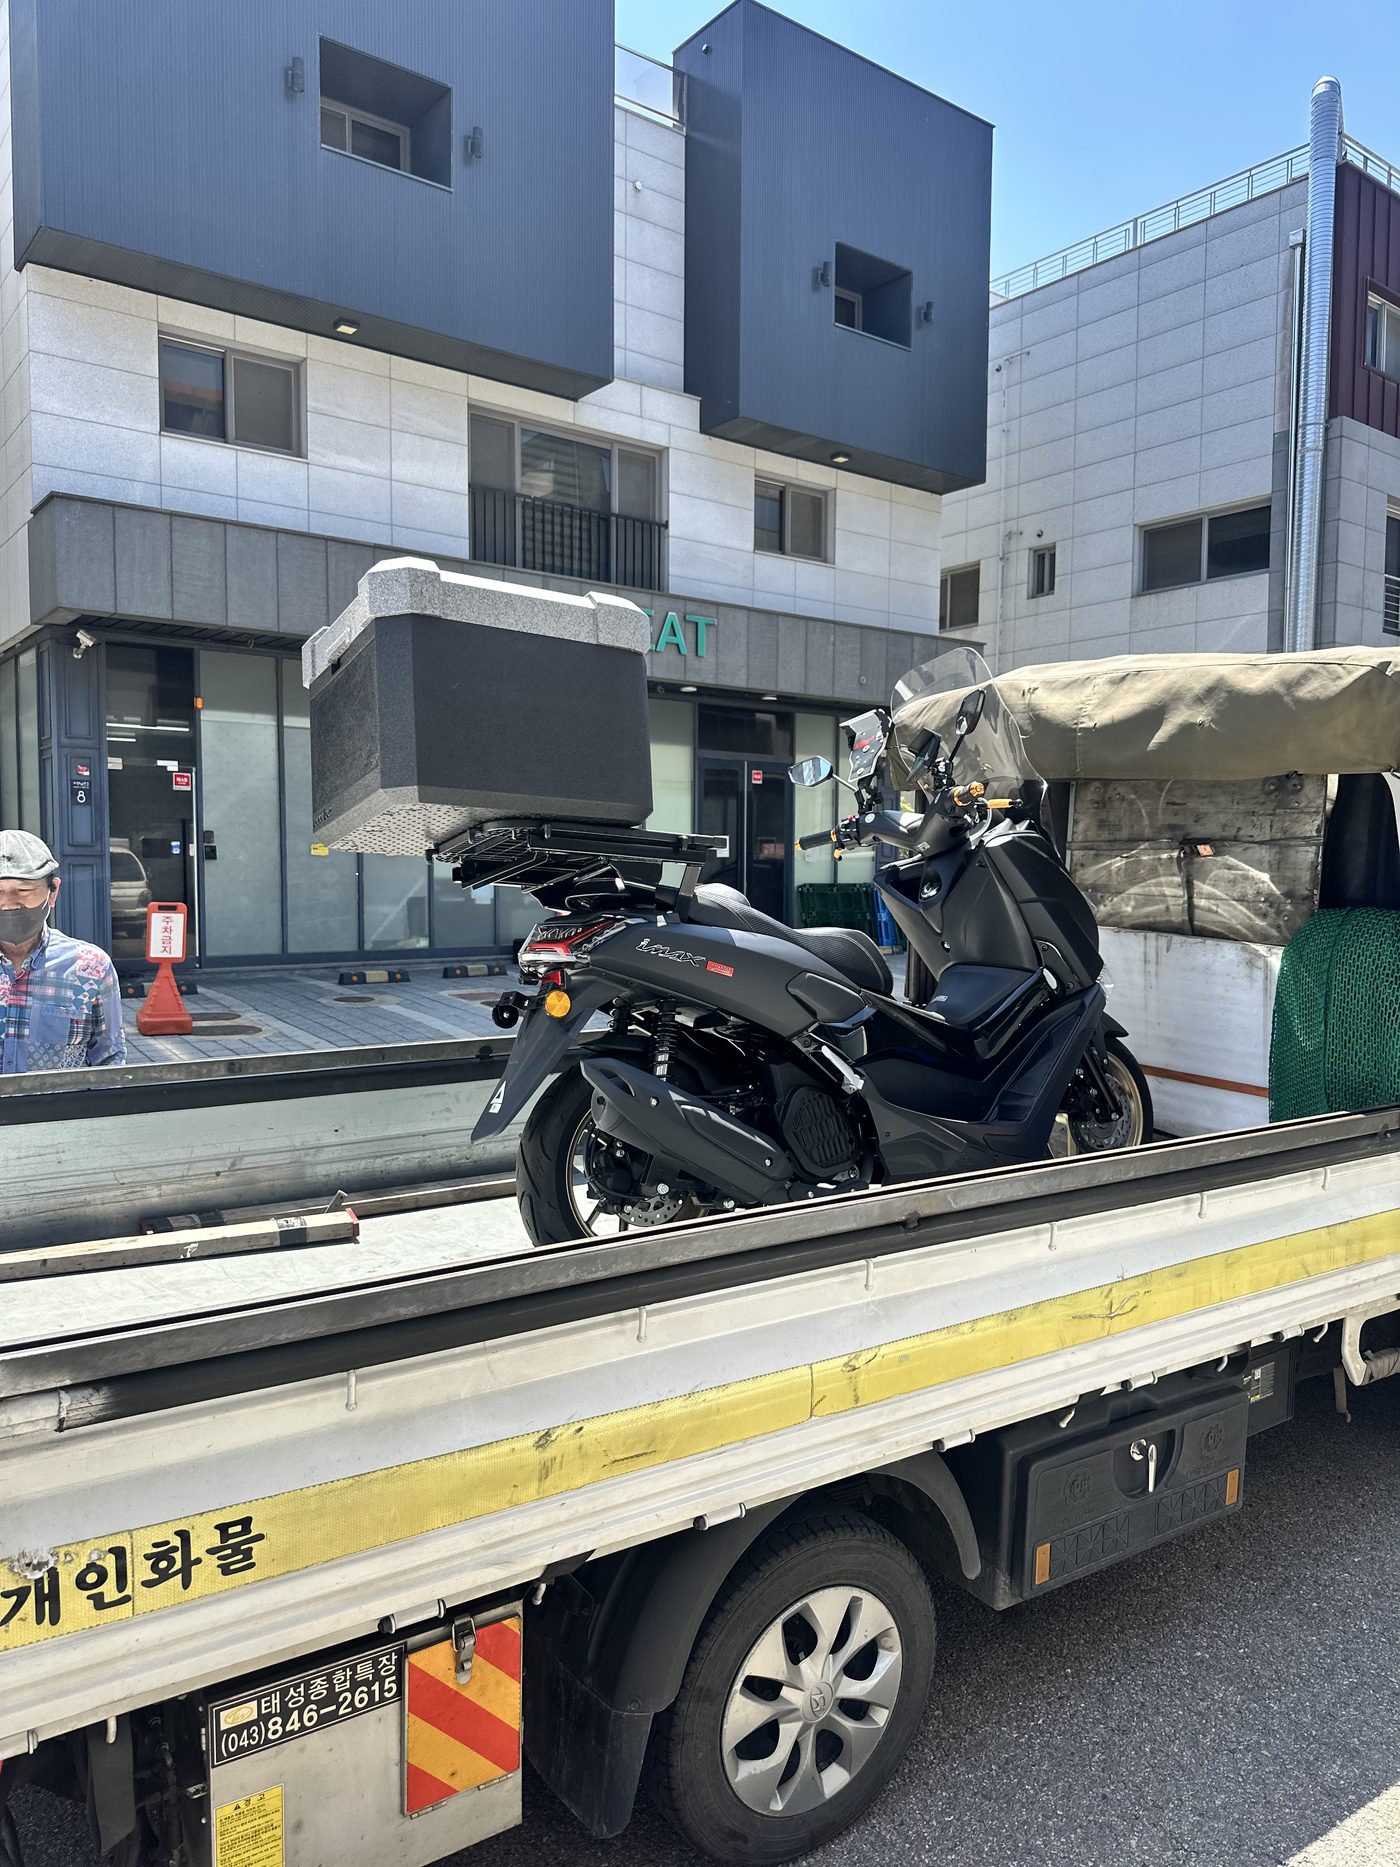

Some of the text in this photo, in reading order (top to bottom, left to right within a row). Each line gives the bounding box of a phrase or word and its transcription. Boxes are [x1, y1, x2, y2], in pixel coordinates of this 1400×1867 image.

[77, 790, 86, 803] 8
[161, 915, 174, 955] 주차금지
[0, 1515, 266, 1627] 개인화물
[261, 1652, 398, 1714] 태성종합특장
